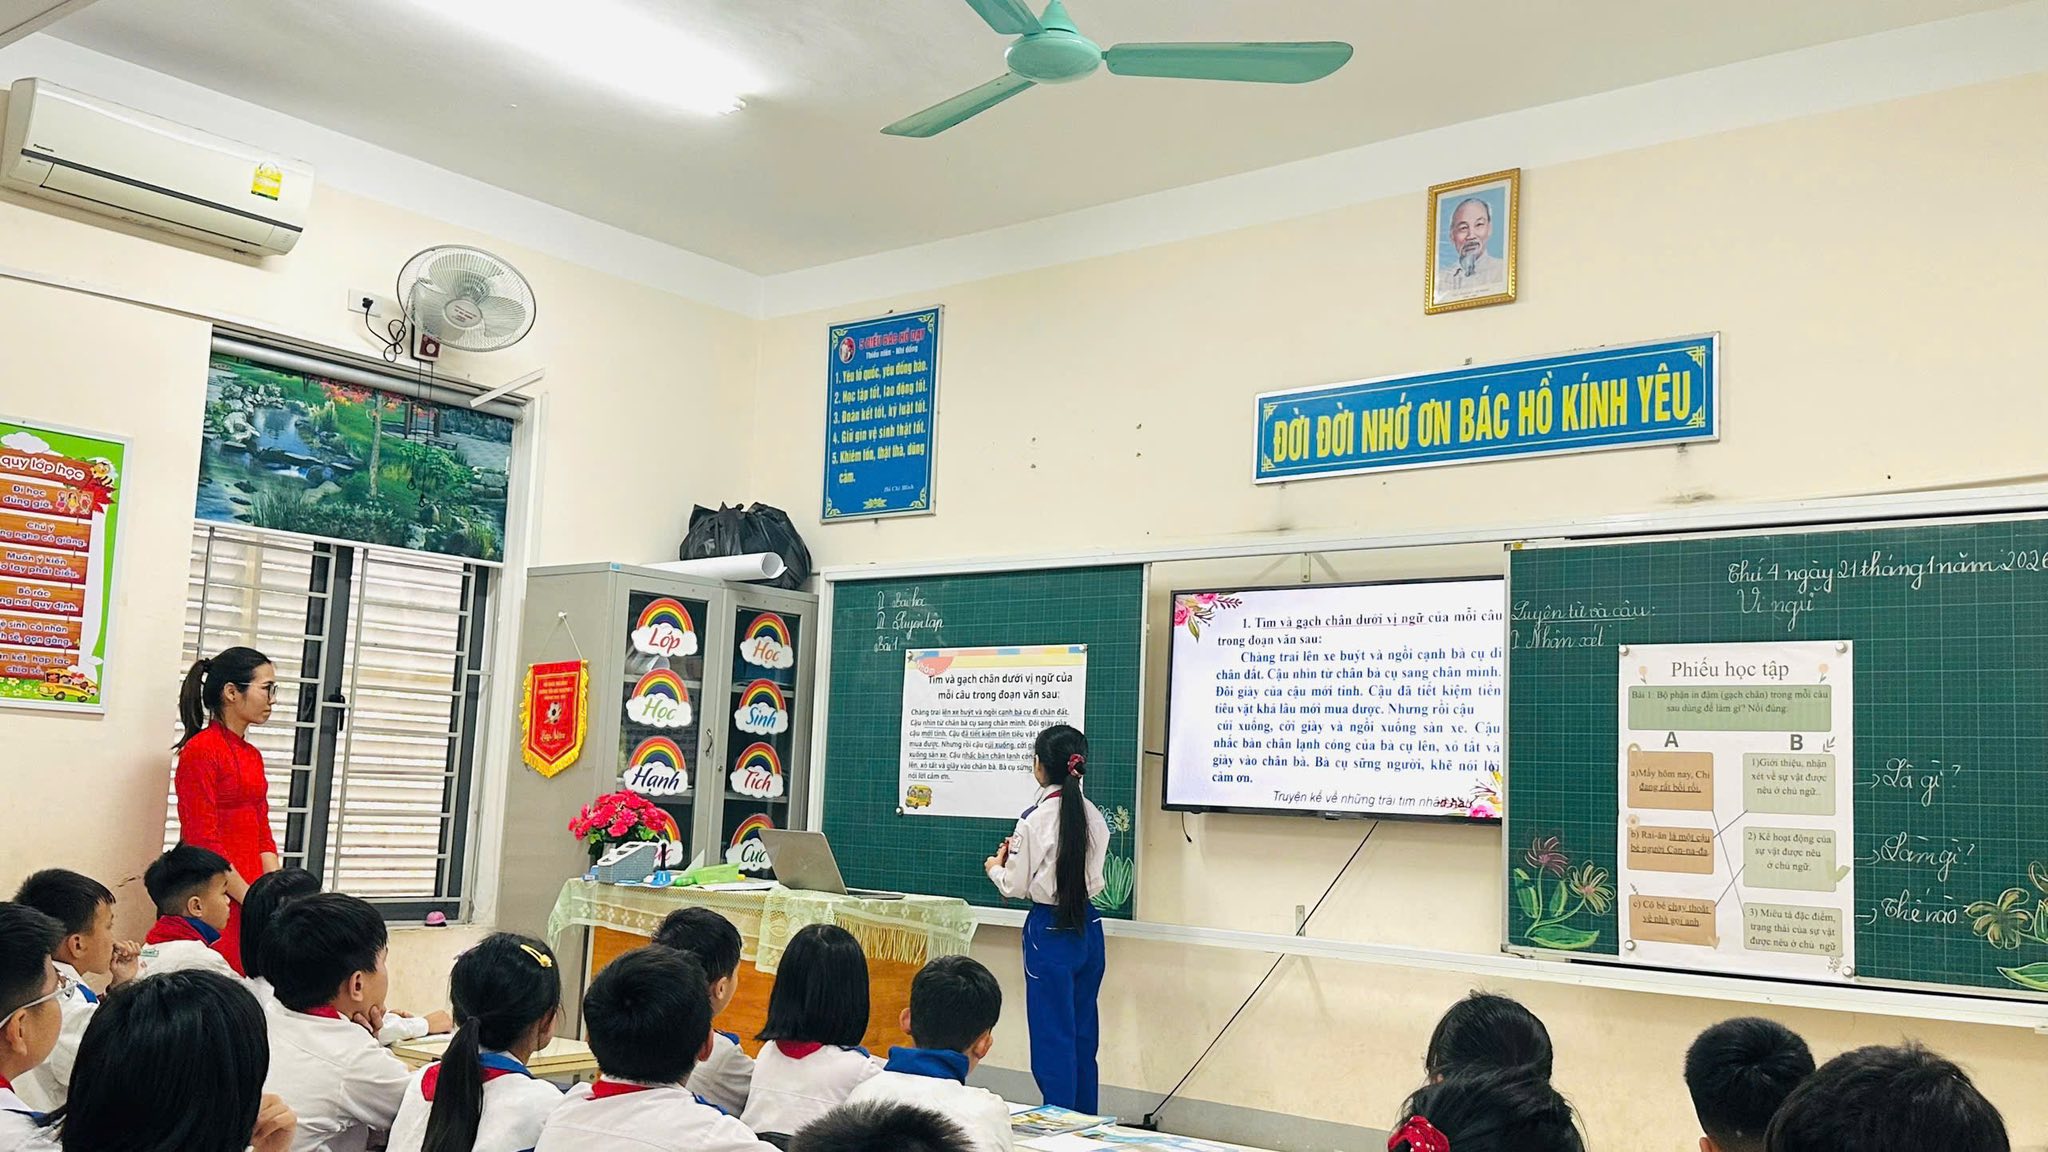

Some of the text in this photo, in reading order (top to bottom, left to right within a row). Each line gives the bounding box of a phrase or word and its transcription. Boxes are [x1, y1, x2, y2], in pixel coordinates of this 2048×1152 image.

[1273, 362, 1692, 463] ĐỜI ĐỜI NHỚ ƠN BÁC HỒ KÍNH YÊU
[1, 457, 84, 480] quy lớp học
[26, 487, 46, 497] học
[1767, 566, 1779, 581] 4
[1786, 559, 1833, 594] ngày
[1837, 560, 1857, 579] 21
[1860, 551, 1925, 590] tháng
[1926, 555, 1935, 574] 1
[1935, 551, 2000, 574] năm
[1242, 607, 1502, 629] 1. Tìm và gạch chân dưới vị ngữ của mỗi câu
[648, 630, 681, 651] Lớp
[1218, 637, 1245, 648] trong
[1278, 634, 1296, 644] văn
[1300, 636, 1322, 644] sau:
[753, 639, 780, 664] Học
[1241, 644, 1484, 665] Chàng trai lên xe buýt và ngồi cạnh bà cụ
[1216, 667, 1428, 682] chân Cậu nhìn từ chân bà cụ sang
[1671, 657, 1789, 680] Phiếu học tập
[945, 674, 955, 684] và
[957, 675, 977, 687] gạch
[979, 674, 999, 684] chân
[1002, 673, 1023, 683] dưới
[1025, 673, 1033, 685] vị
[1036, 673, 1053, 685] ngữ
[1056, 673, 1073, 683] của
[956, 690, 970, 699] câu
[973, 690, 996, 701] trong
[999, 690, 1020, 700] đoạn
[1023, 689, 1039, 699] văn
[1042, 690, 1060, 699] sau:
[642, 697, 676, 721] Học
[746, 704, 777, 729] Sinh
[1664, 732, 1679, 747] A
[1790, 734, 1803, 751] B
[631, 766, 680, 793] Hạnh
[743, 770, 771, 792] Tích
[1212, 771, 1253, 783] cảm ơn.
